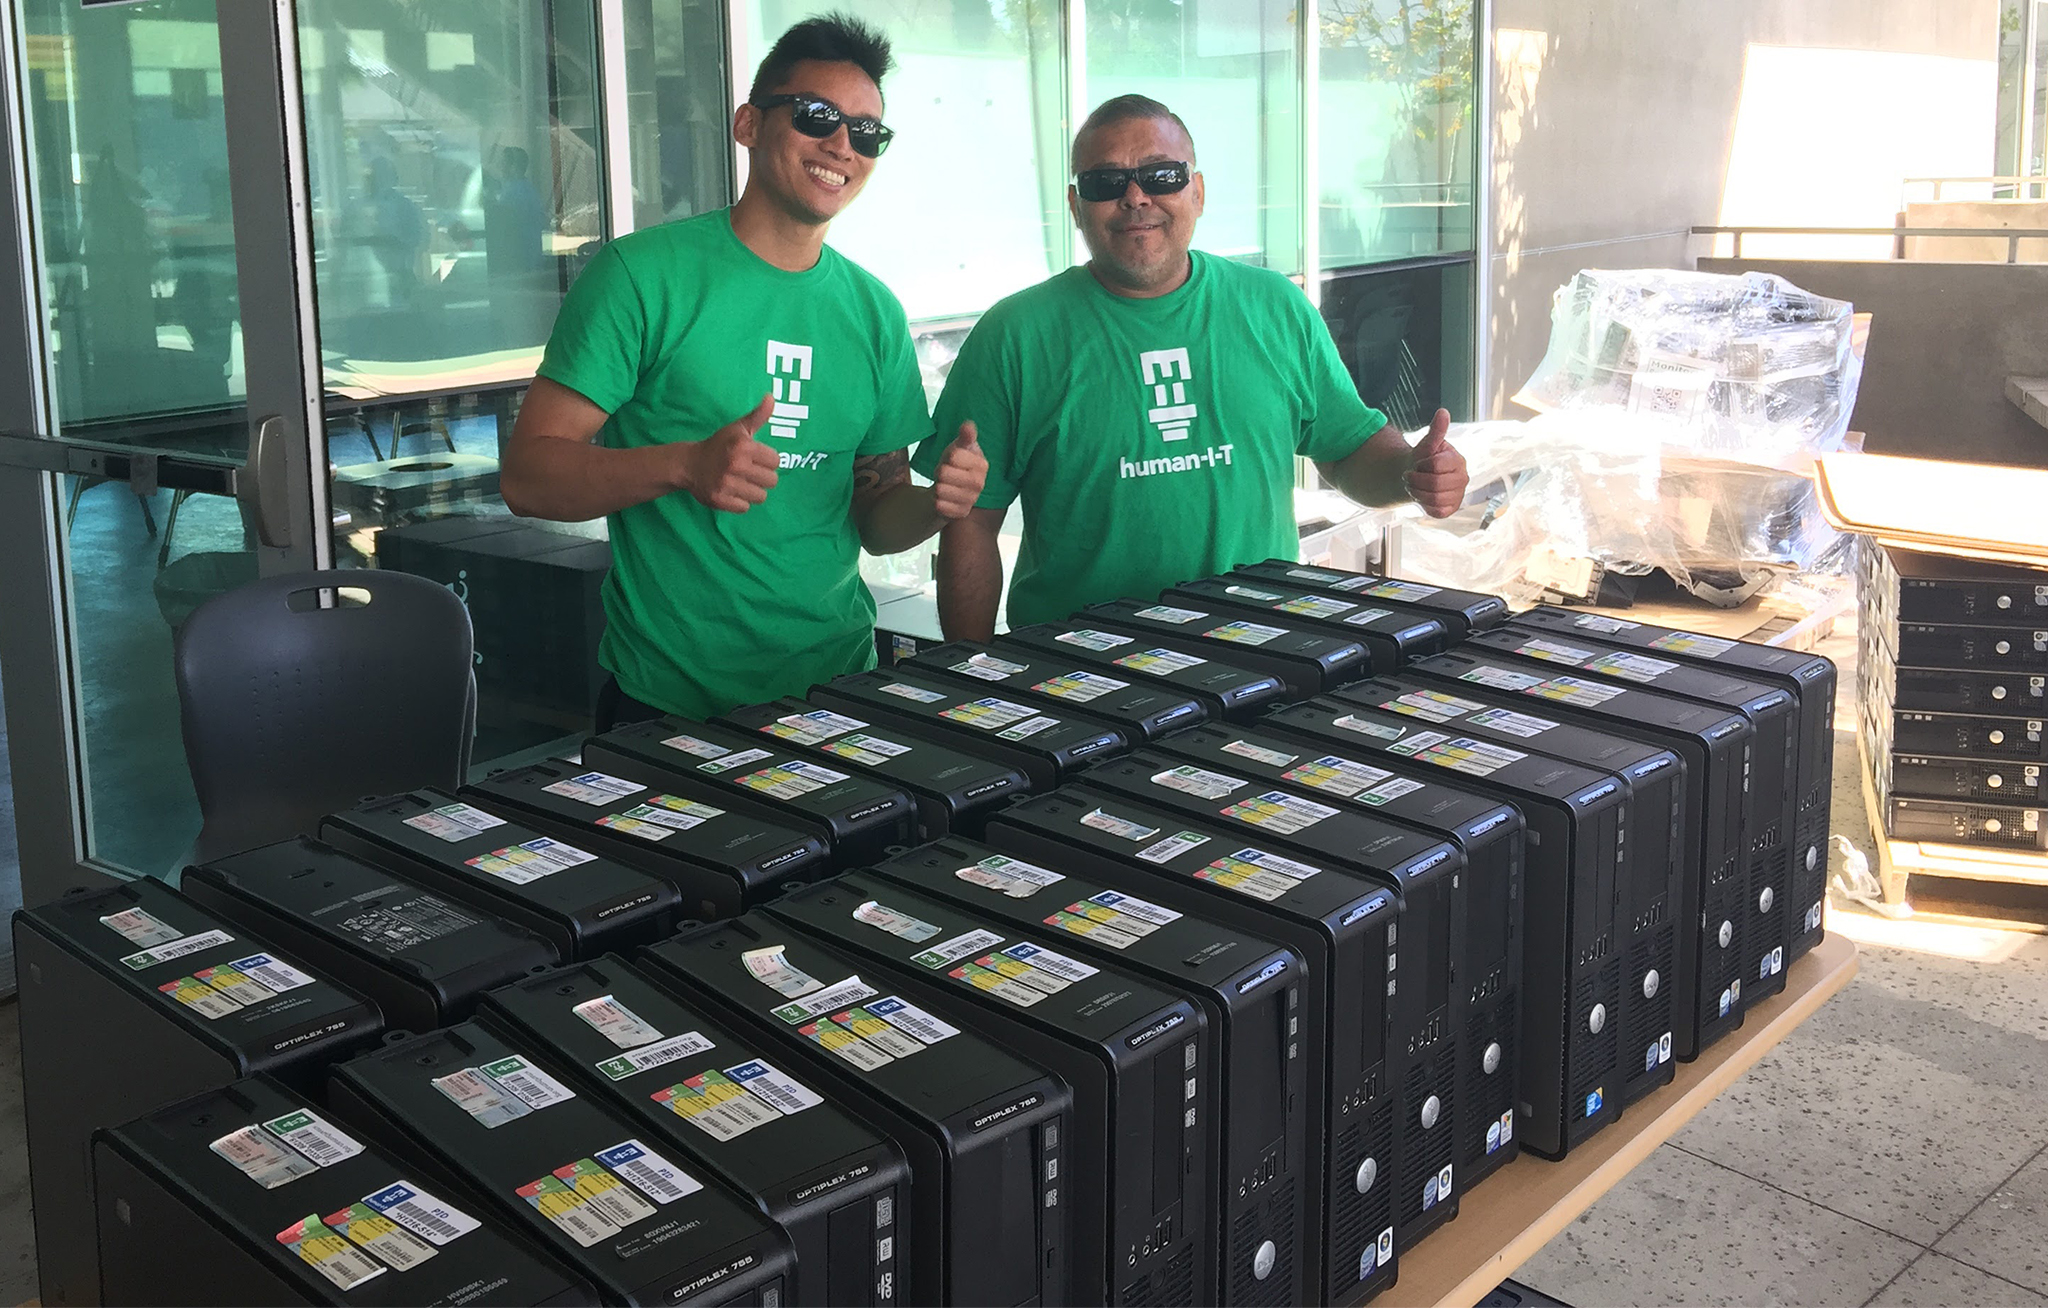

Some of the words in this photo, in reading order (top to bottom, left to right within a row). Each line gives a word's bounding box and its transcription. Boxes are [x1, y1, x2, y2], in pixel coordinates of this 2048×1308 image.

[1119, 443, 1235, 479] human-I-T
[850, 805, 880, 821] OPTIPLEX
[761, 852, 792, 869] OPTIPLEX
[598, 901, 635, 918] OPTIPLEX
[636, 894, 652, 905] 755
[920, 1017, 935, 1026] PID
[274, 1028, 324, 1050] OPTIPLEX
[325, 1020, 346, 1032] 755
[782, 1084, 797, 1094] PID
[974, 1103, 1018, 1128] OPTIPLEX
[1018, 1096, 1038, 1110] 755
[658, 1168, 675, 1179] PID
[796, 1174, 847, 1200] OPTIPLEX
[848, 1165, 870, 1179] 755
[430, 1207, 449, 1219] PID
[673, 1265, 729, 1300] OPTIPLEX
[730, 1255, 754, 1273] 755
[885, 1272, 893, 1300] DVD
